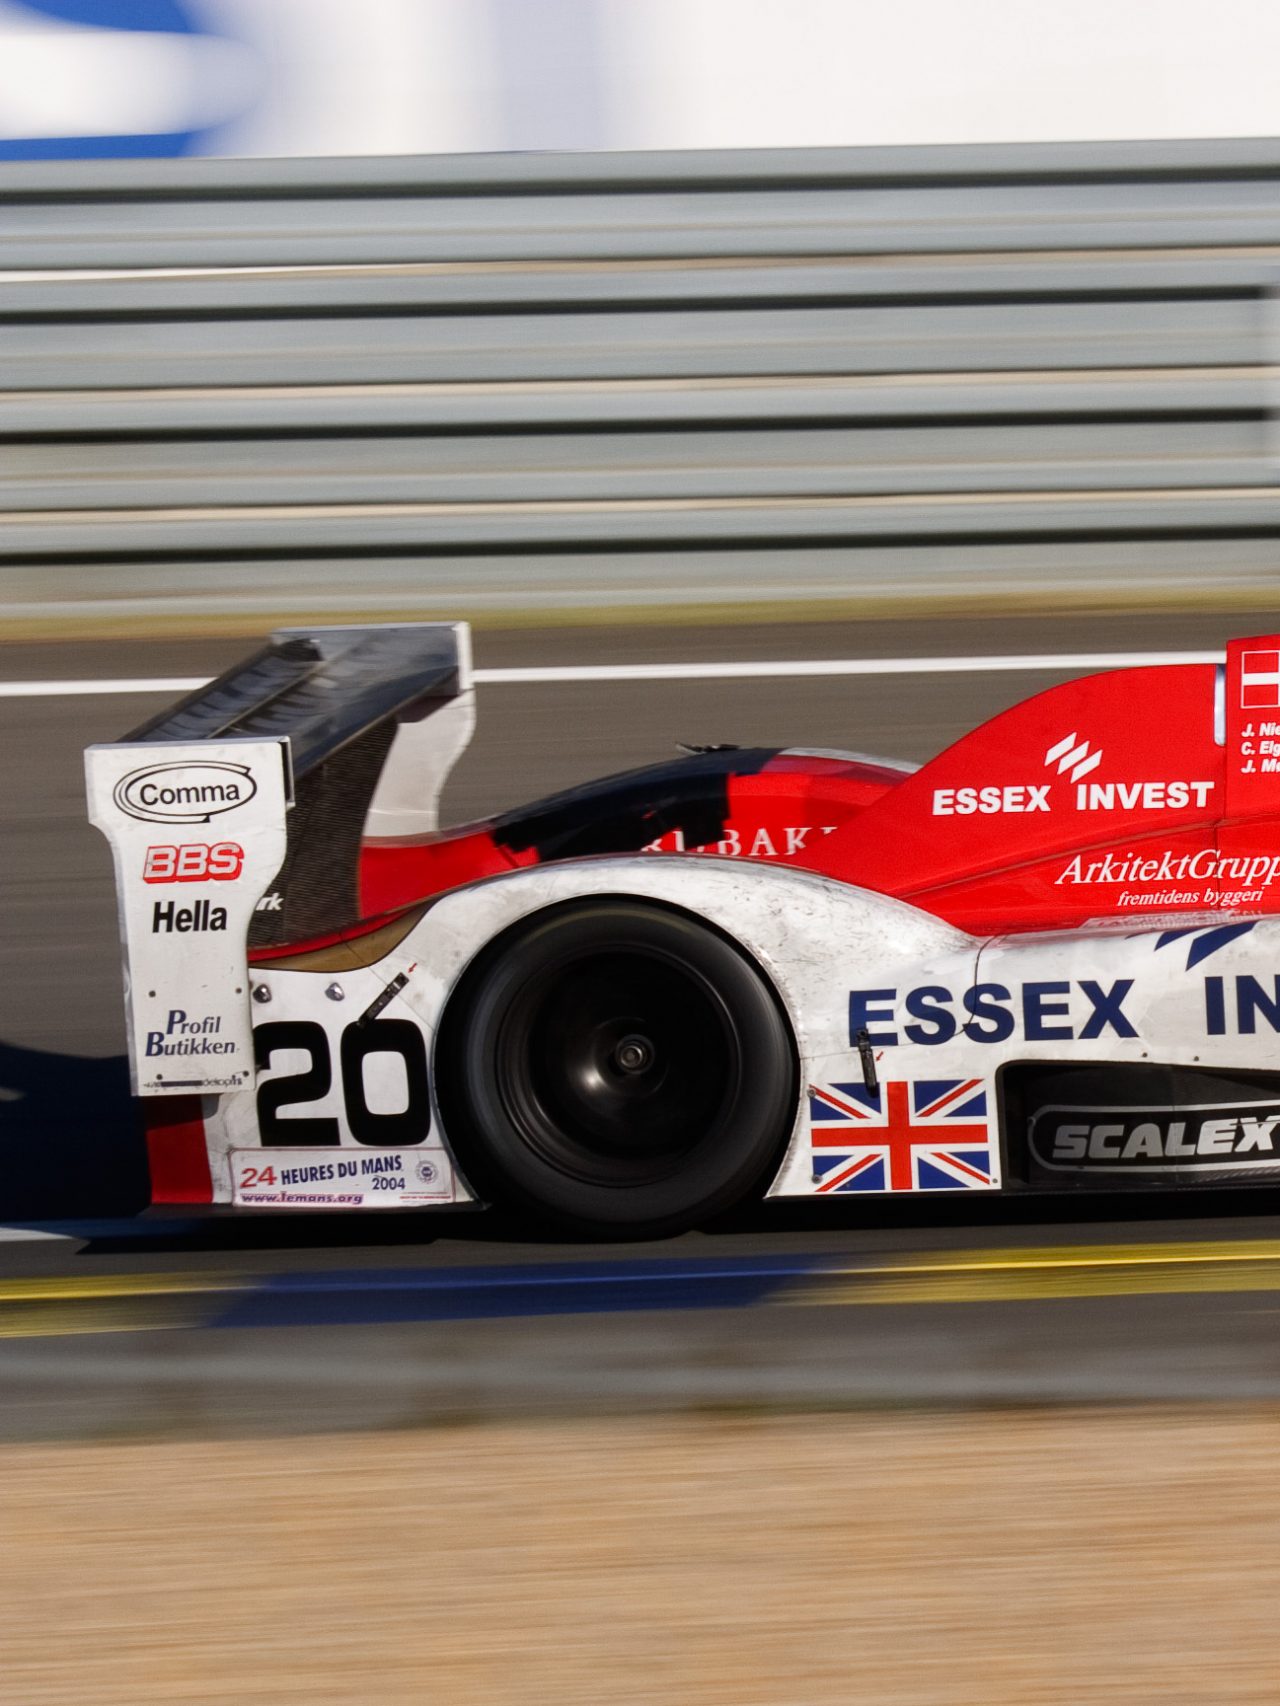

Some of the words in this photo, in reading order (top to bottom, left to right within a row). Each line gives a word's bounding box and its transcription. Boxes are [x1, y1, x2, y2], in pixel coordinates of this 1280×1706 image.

[1241, 723, 1255, 737] J.
[1241, 741, 1255, 755] C.
[1241, 759, 1256, 773] J.
[140, 783, 240, 806] Comma
[932, 785, 1051, 816] ESSEX
[1076, 781, 1215, 810] INVEST
[143, 841, 245, 884] BBS
[1117, 889, 1199, 906] fremtidens
[1203, 887, 1264, 907] byggeri
[152, 900, 228, 933] Hella
[165, 1009, 222, 1036] Profil
[848, 978, 1140, 1049] ESSEX
[145, 1031, 236, 1057] Butikken
[252, 1018, 431, 1147] 20
[240, 1166, 277, 1188] 24
[281, 1162, 334, 1185] HEURES
[338, 1161, 357, 1177] DU
[361, 1155, 402, 1175] MANS
[372, 1177, 406, 1190] 2004
[240, 1191, 364, 1205] www.lemans.org
